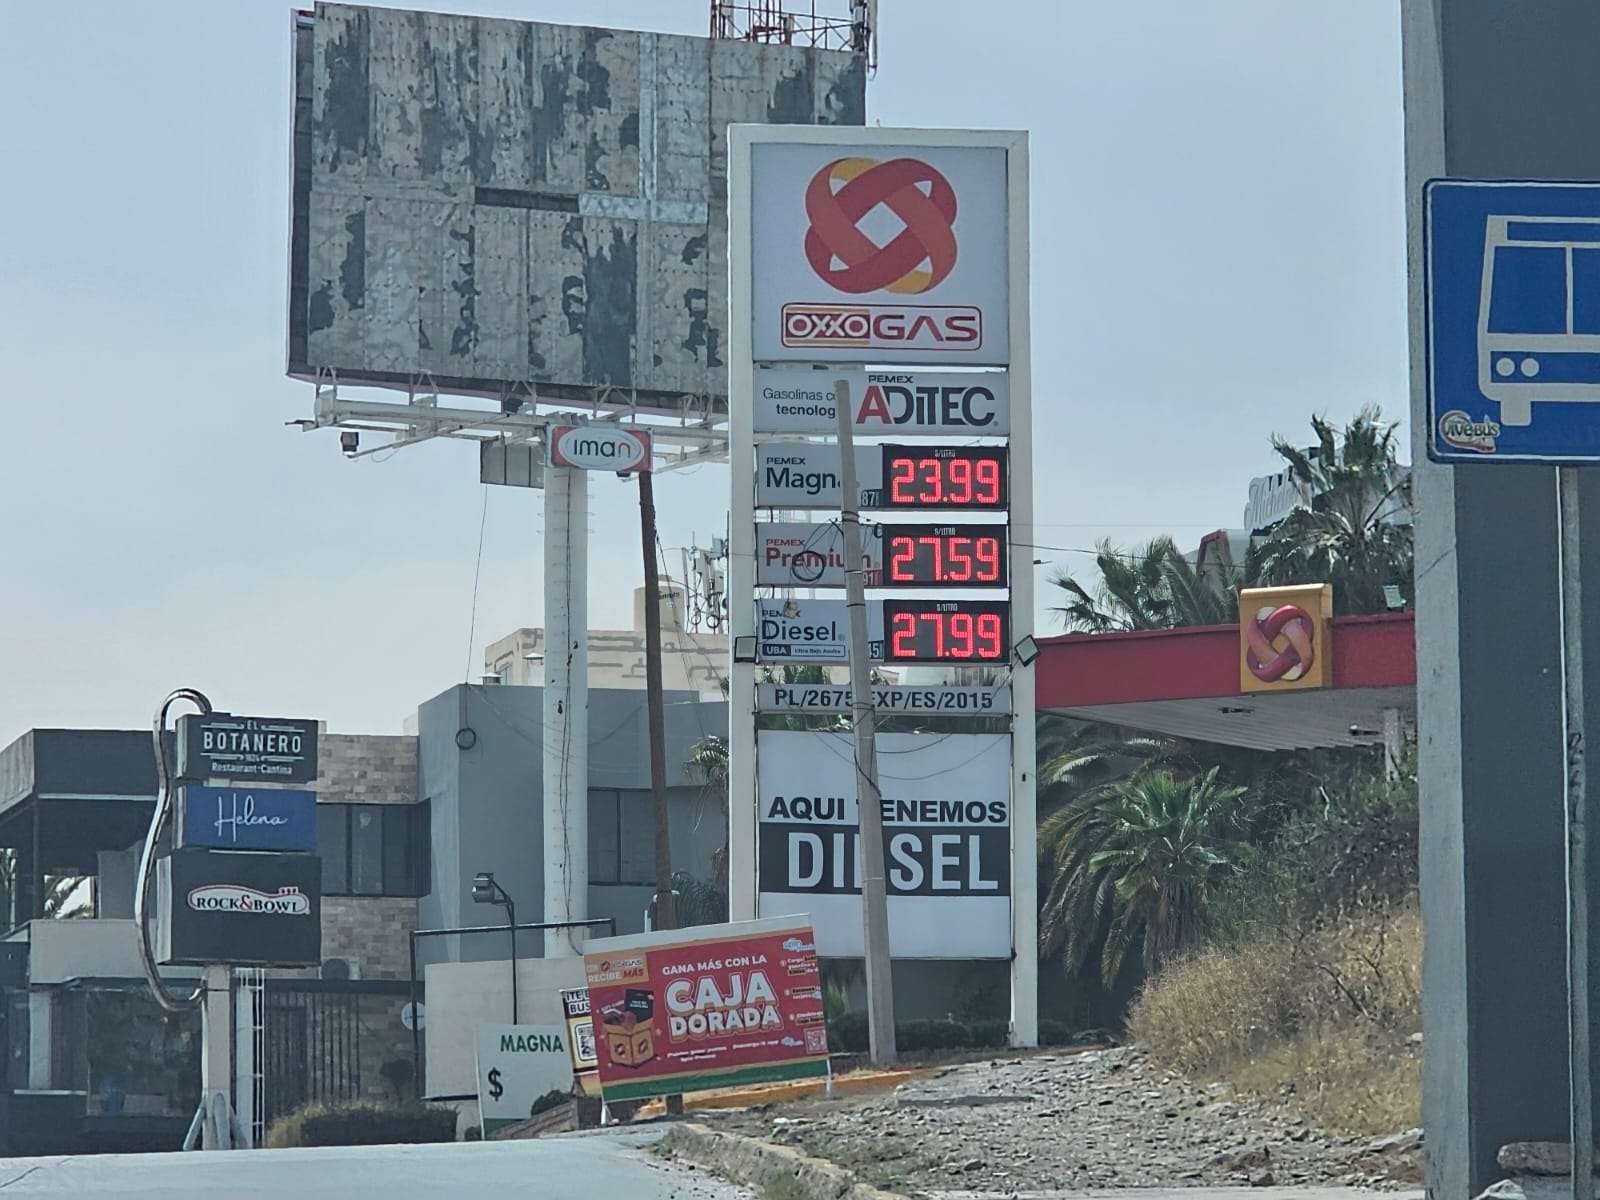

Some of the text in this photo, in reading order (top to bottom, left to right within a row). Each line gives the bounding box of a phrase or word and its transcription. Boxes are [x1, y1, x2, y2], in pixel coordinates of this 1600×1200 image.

[868, 375, 913, 384] PEMEX
[763, 387, 823, 401] Gasolinas
[776, 403, 836, 419] tecnolog
[766, 457, 806, 465] PEMEX
[766, 467, 841, 495] Magn
[892, 459, 999, 503] 23.99
[766, 539, 805, 547] PEMEX
[892, 537, 999, 581] 27.59
[762, 620, 836, 641] Diesel
[893, 613, 1001, 657] 27.99
[766, 645, 787, 655] UBA
[246, 720, 258, 730] EL
[203, 731, 302, 753] BOTANERO
[214, 793, 288, 842] Helena
[768, 797, 1007, 823] AQUI ENEMOS
[662, 954, 767, 976] GANA MÁS CON LA
[666, 971, 775, 1012] CAJA
[670, 1005, 779, 1037] DORADA
[500, 1034, 564, 1052] MAGNA
[487, 1066, 503, 1101] $
